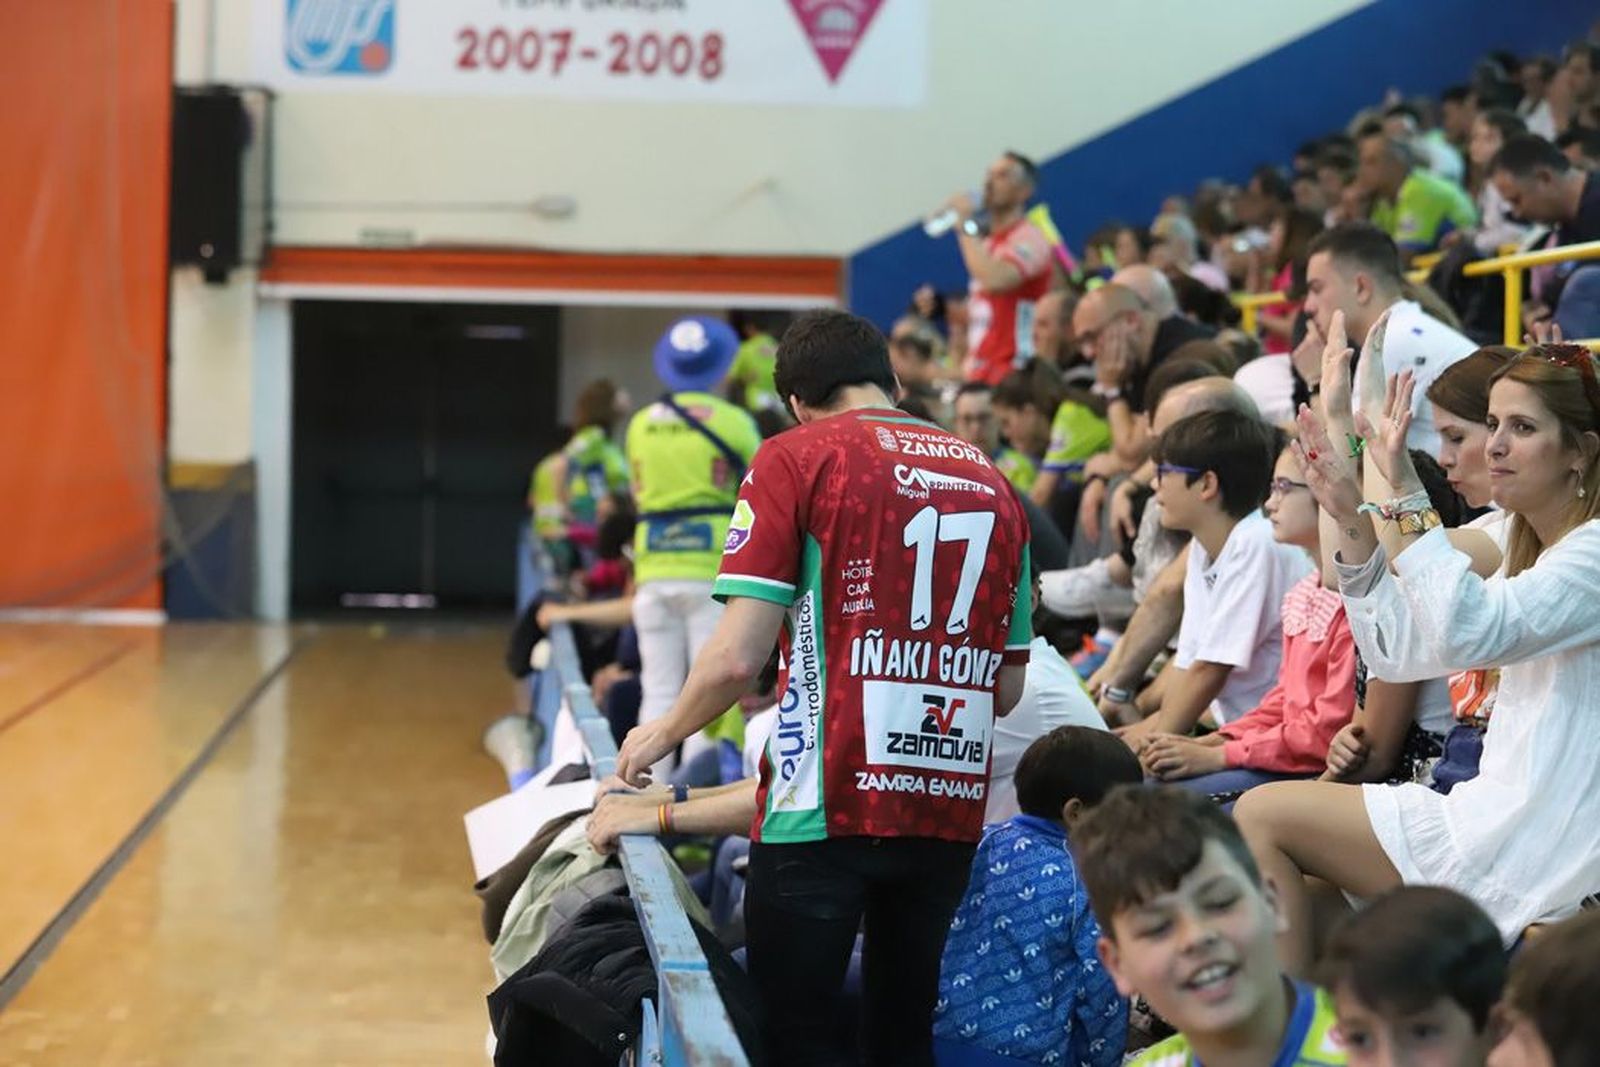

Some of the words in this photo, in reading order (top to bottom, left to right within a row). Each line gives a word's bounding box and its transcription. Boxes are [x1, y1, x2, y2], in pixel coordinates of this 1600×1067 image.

[456, 27, 725, 81] 2007-2008
[899, 438, 992, 470] ZAMORA
[896, 485, 930, 499] Miguel
[904, 506, 996, 636] 17
[850, 628, 931, 679] IÑAKI
[886, 731, 984, 764] zamovia
